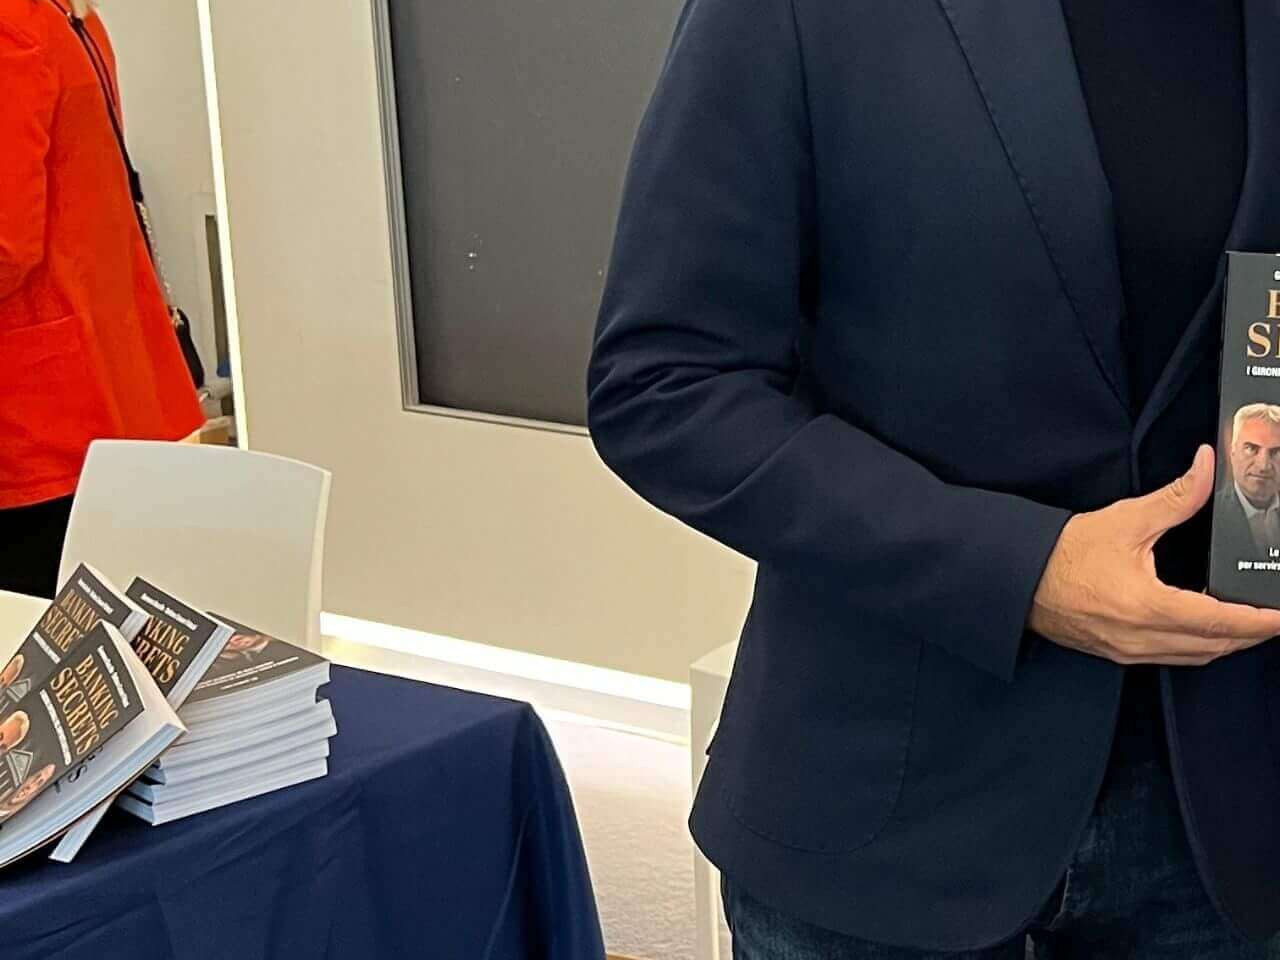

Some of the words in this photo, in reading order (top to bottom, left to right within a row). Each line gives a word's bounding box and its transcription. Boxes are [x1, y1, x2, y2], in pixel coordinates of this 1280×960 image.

[1252, 366, 1280, 377] GIRONI
[40, 605, 85, 653] SECRE
[136, 636, 181, 684] RETS
[50, 667, 100, 756] SECRETS
[75, 653, 119, 730] BANKING
